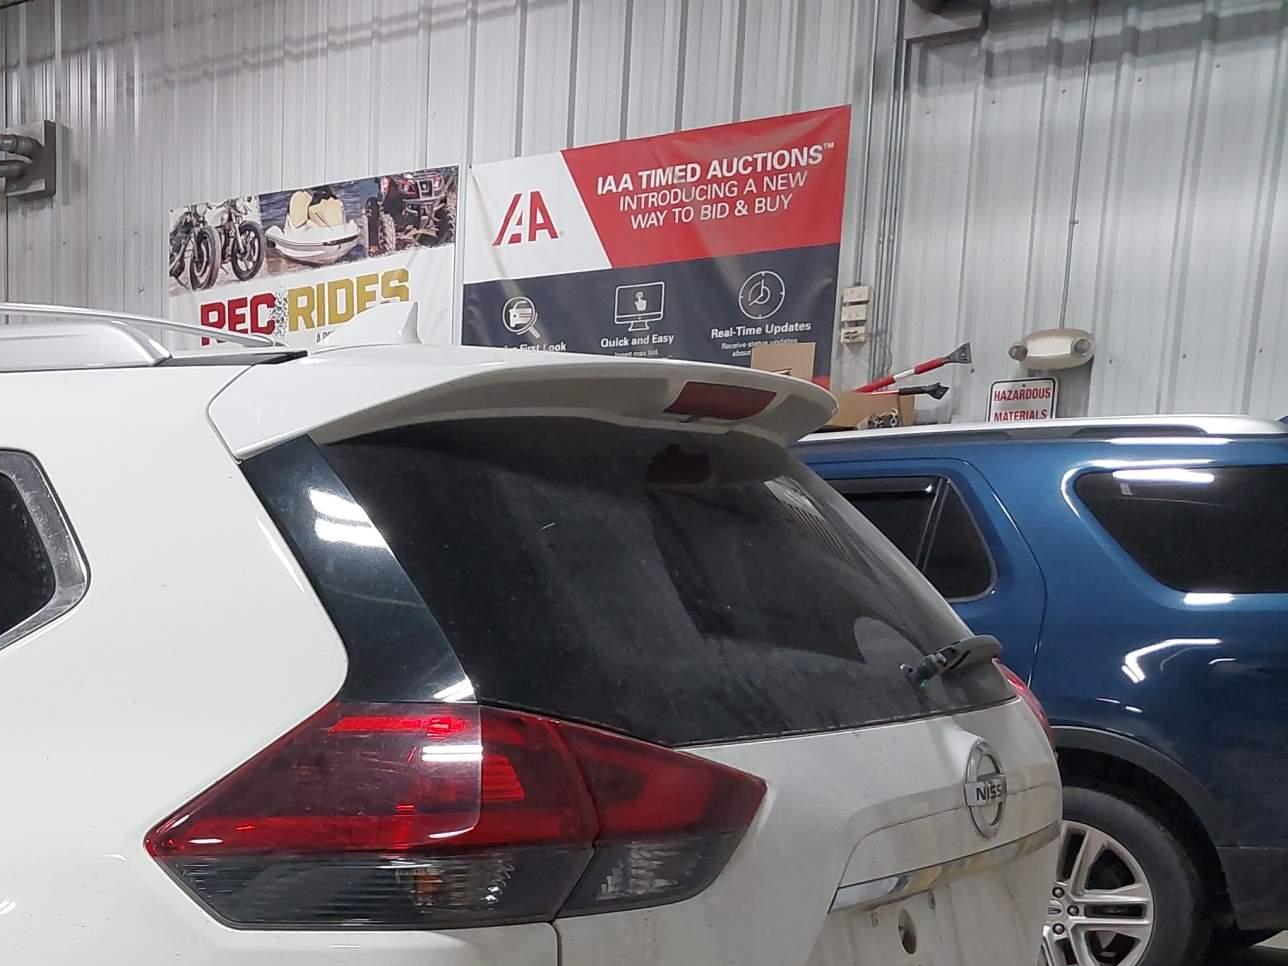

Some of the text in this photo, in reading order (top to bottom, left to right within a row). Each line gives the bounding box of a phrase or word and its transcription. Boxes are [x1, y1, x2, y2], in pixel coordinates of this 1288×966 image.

[597, 173, 634, 195] IAA
[637, 163, 701, 190] TIMED
[619, 170, 808, 212] INTRODUCING A NEW
[631, 193, 793, 230] WAY TO BID & BUY
[200, 268, 410, 346] REC RIDES
[711, 322, 812, 339] Real-Time Updates
[600, 333, 675, 348] Quick and Easy
[994, 388, 1051, 401] HAZARDOUS
[994, 409, 1048, 421] MATERIALS
[976, 783, 1003, 801] NISS
